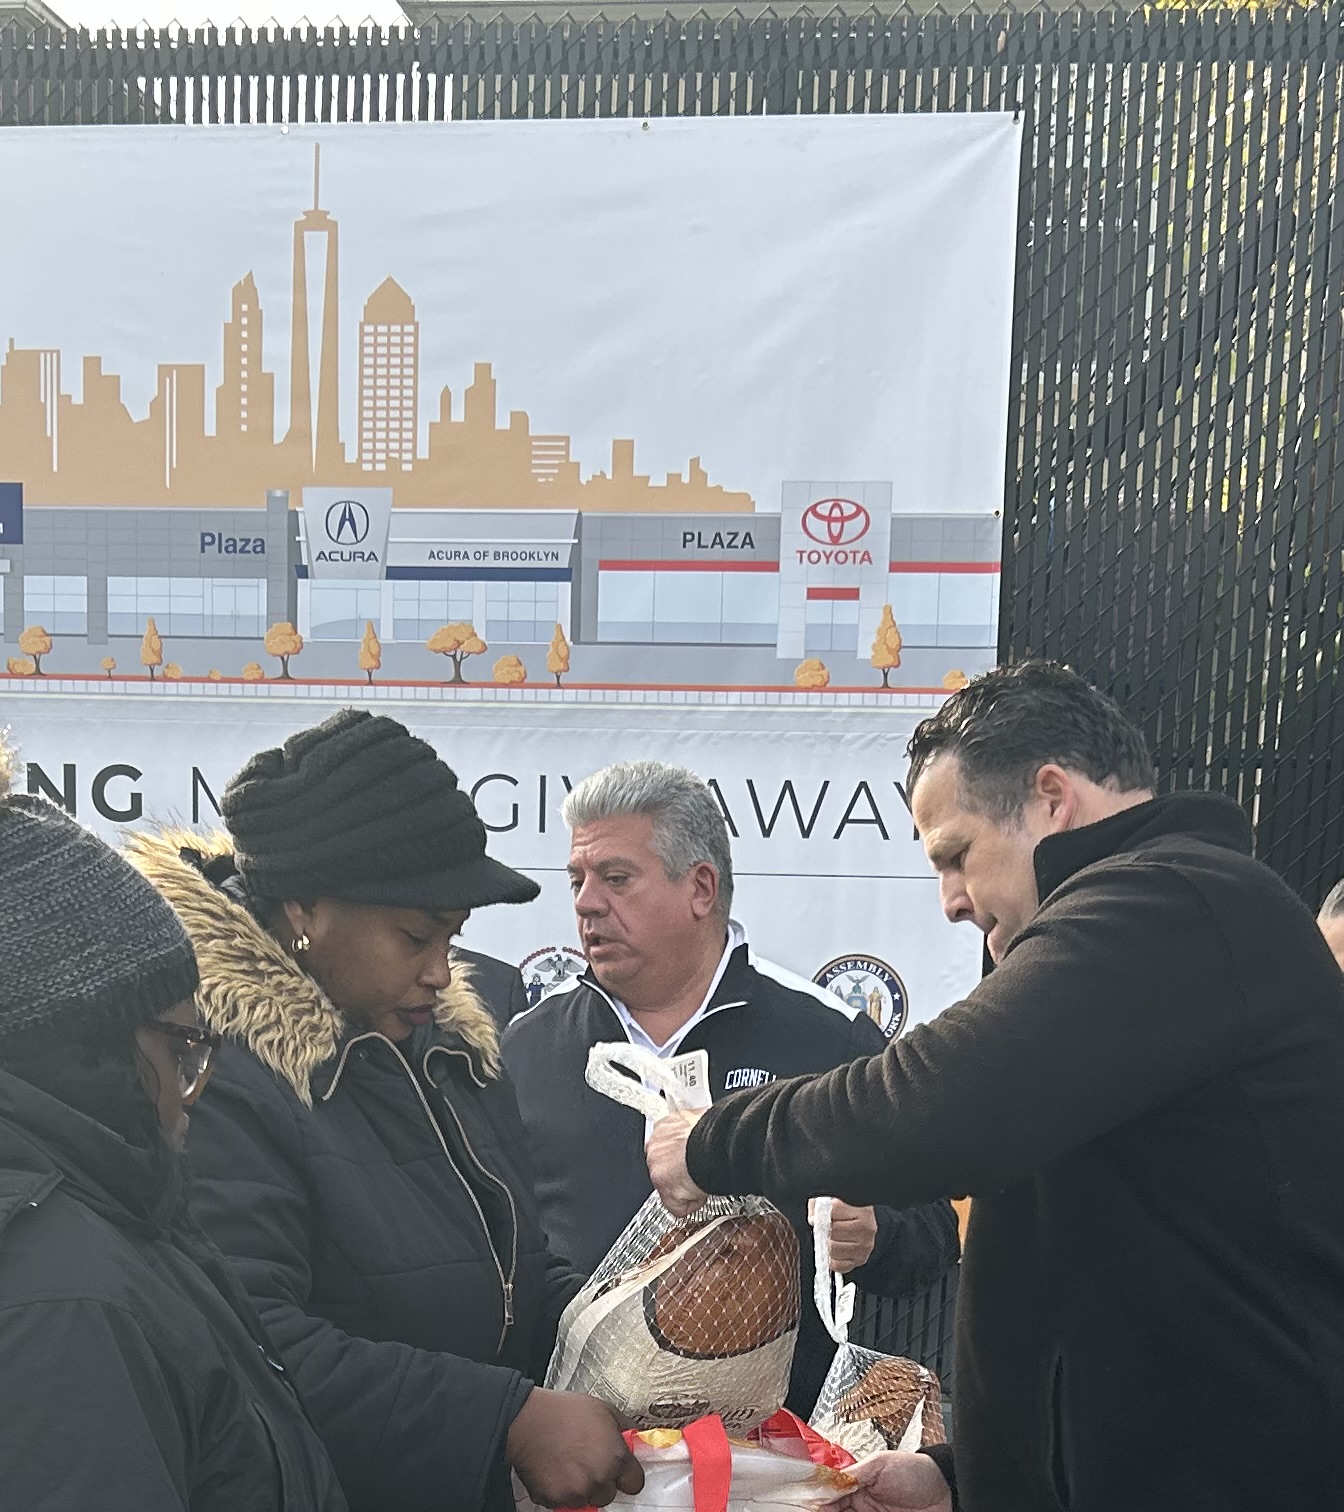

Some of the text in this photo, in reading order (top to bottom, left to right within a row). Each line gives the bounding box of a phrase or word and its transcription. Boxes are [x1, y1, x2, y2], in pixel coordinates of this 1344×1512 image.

[200, 531, 266, 556] Plaza
[682, 531, 755, 550] PLAZA
[315, 551, 379, 563] ACURA
[428, 549, 560, 563] ACURA OF BROOKLYN
[796, 549, 874, 566] TOYOTA
[825, 961, 893, 983] ASSEMBLY
